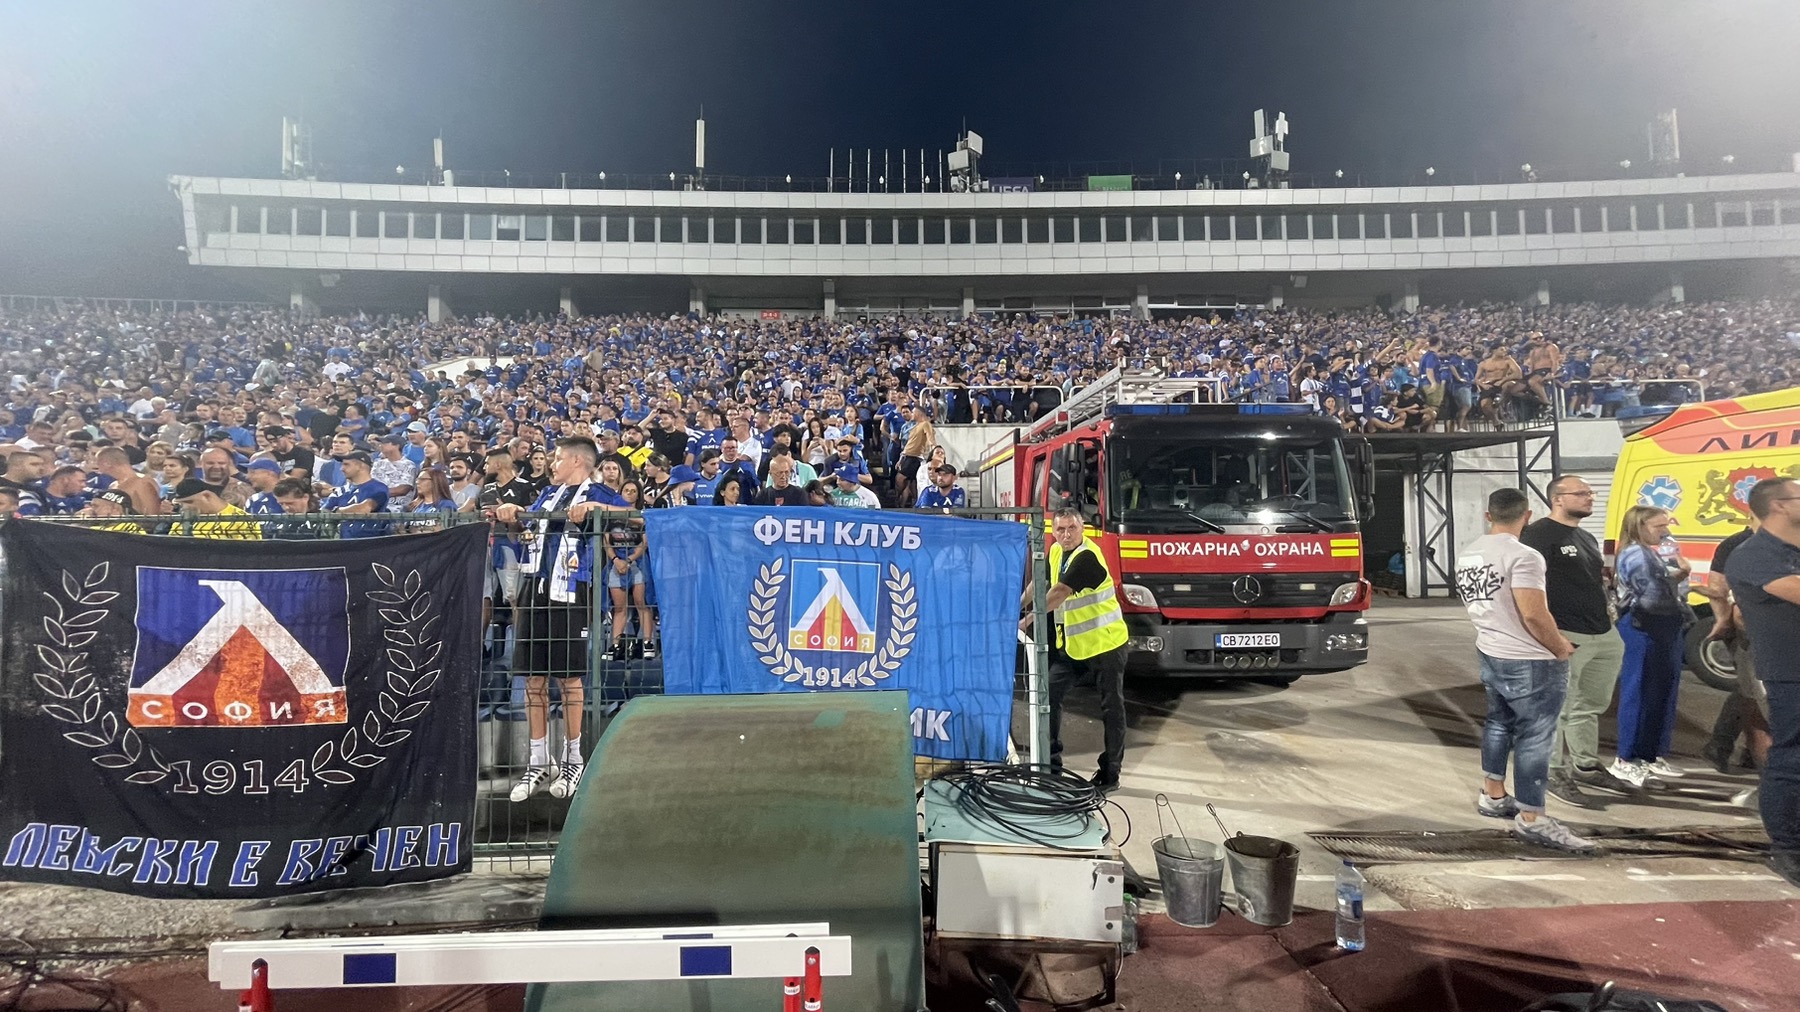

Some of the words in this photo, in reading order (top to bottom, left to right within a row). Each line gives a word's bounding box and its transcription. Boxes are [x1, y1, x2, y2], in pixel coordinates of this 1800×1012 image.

[1698, 430, 1800, 453] ЛИ
[833, 497, 867, 509] ULGARIA
[753, 515, 825, 546] ФЕН
[834, 521, 922, 550] КЛУБ
[1150, 542, 1241, 556] ПОЖАРНА
[1254, 542, 1324, 556] ОХРАНА
[803, 666, 858, 688] 1914
[142, 698, 336, 722] СОФИЯ
[170, 759, 310, 794] 1914
[3, 823, 219, 886] ЛЕВСКИ
[228, 840, 271, 887] Е
[276, 822, 461, 886] ВЕЧЕН
